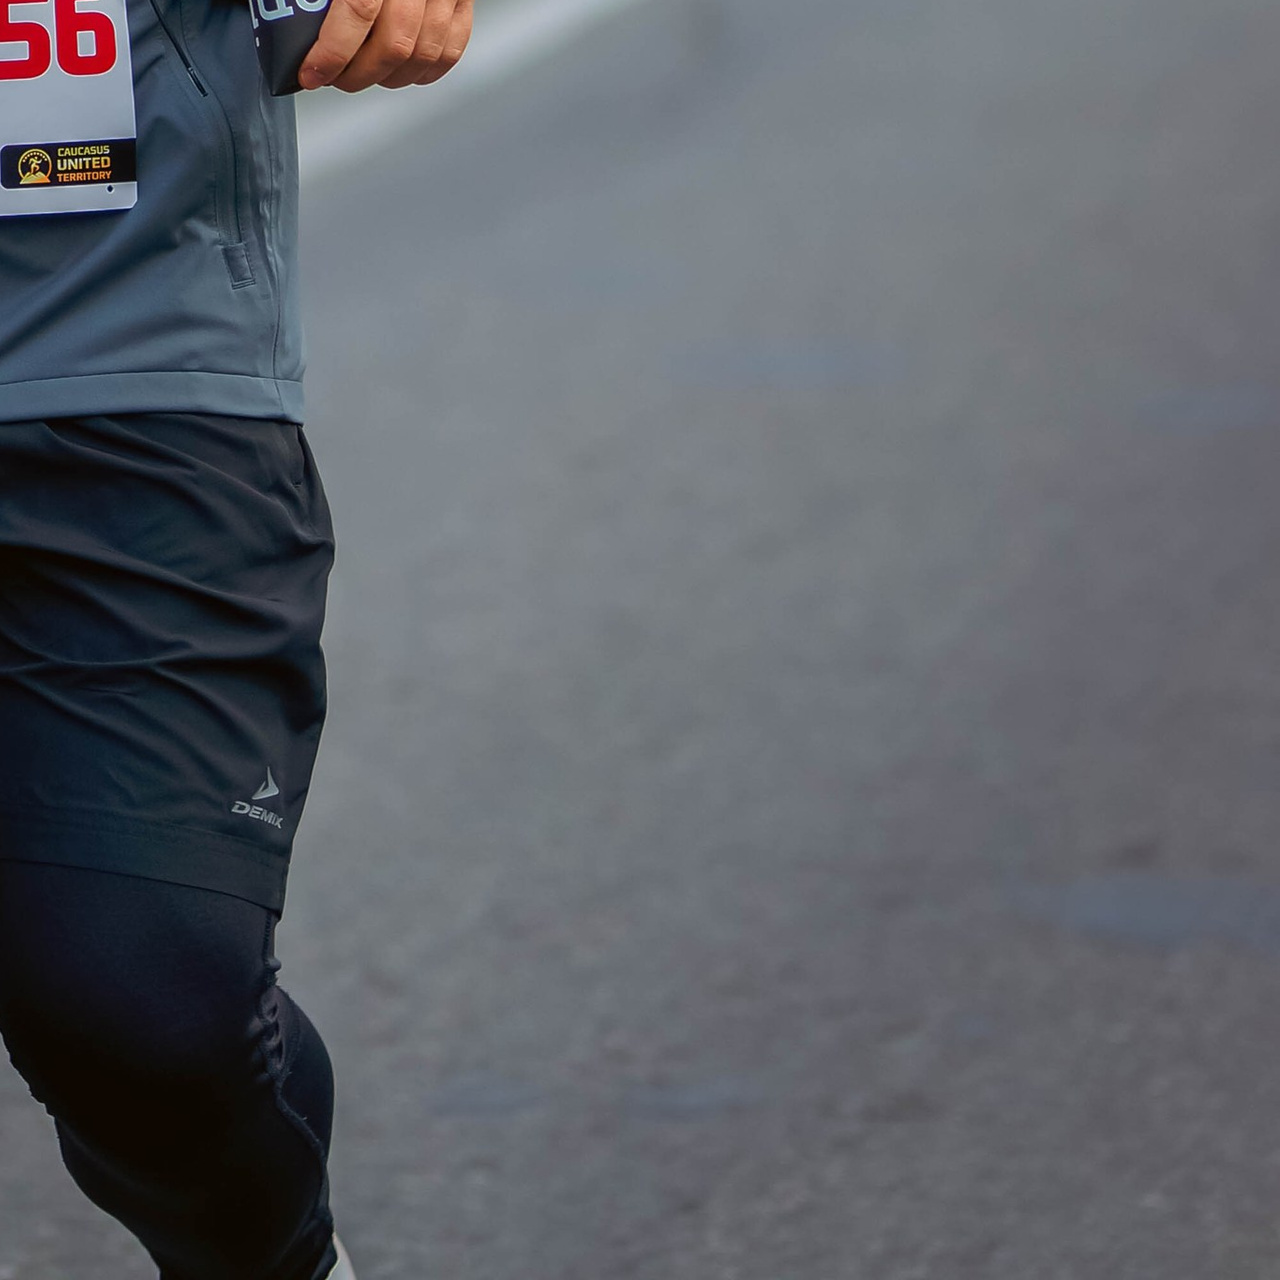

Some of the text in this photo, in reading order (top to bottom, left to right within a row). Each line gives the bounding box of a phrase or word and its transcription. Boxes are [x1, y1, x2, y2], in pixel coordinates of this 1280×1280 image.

[57, 145, 111, 157] CAUCASUS
[57, 156, 112, 171] UNITED
[56, 170, 113, 183] TERRITORY
[230, 800, 284, 829] DEMIX
